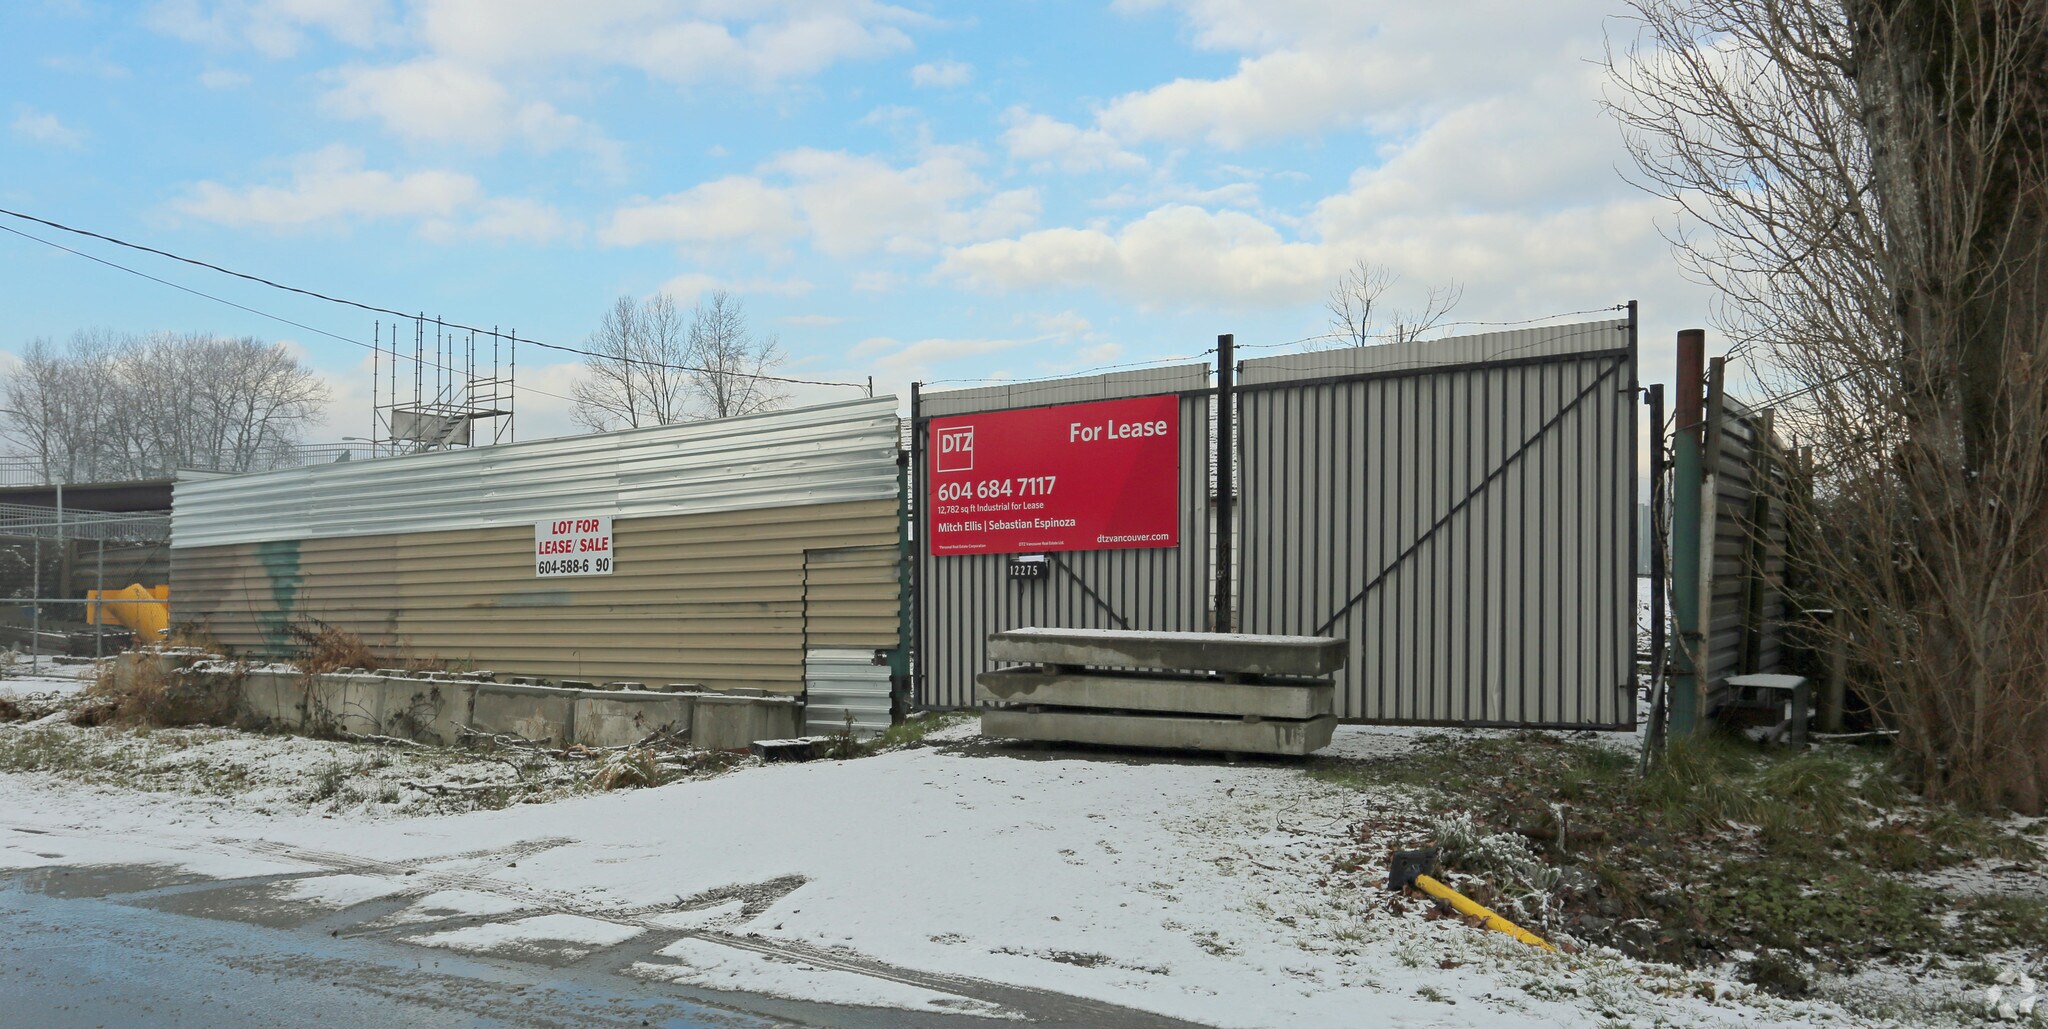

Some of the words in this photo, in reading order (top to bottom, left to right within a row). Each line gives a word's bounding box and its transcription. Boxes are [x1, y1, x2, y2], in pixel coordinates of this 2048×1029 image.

[1070, 422, 1102, 443] For
[1108, 420, 1167, 440] Lease
[942, 432, 973, 453] DTZ
[938, 481, 973, 501] 604
[977, 479, 1012, 499] 684
[1017, 475, 1056, 496] 7117
[938, 505, 960, 515] 12,782
[960, 506, 969, 514] sq
[970, 504, 976, 513] ft
[977, 502, 1010, 512] Industrial
[1011, 501, 1022, 511] for
[1023, 501, 1044, 510] Lease
[552, 521, 573, 535] LOT
[575, 519, 599, 533] FOR
[938, 522, 963, 533] Mitch
[964, 521, 982, 531] Ellis
[988, 518, 1032, 530] Sebastian
[1034, 518, 1076, 529] Espinoza
[538, 539, 578, 555] LEASE/
[579, 537, 609, 552] SALE
[1097, 533, 1169, 543] dtzvancouver.com
[1010, 565, 1038, 576] 12275
